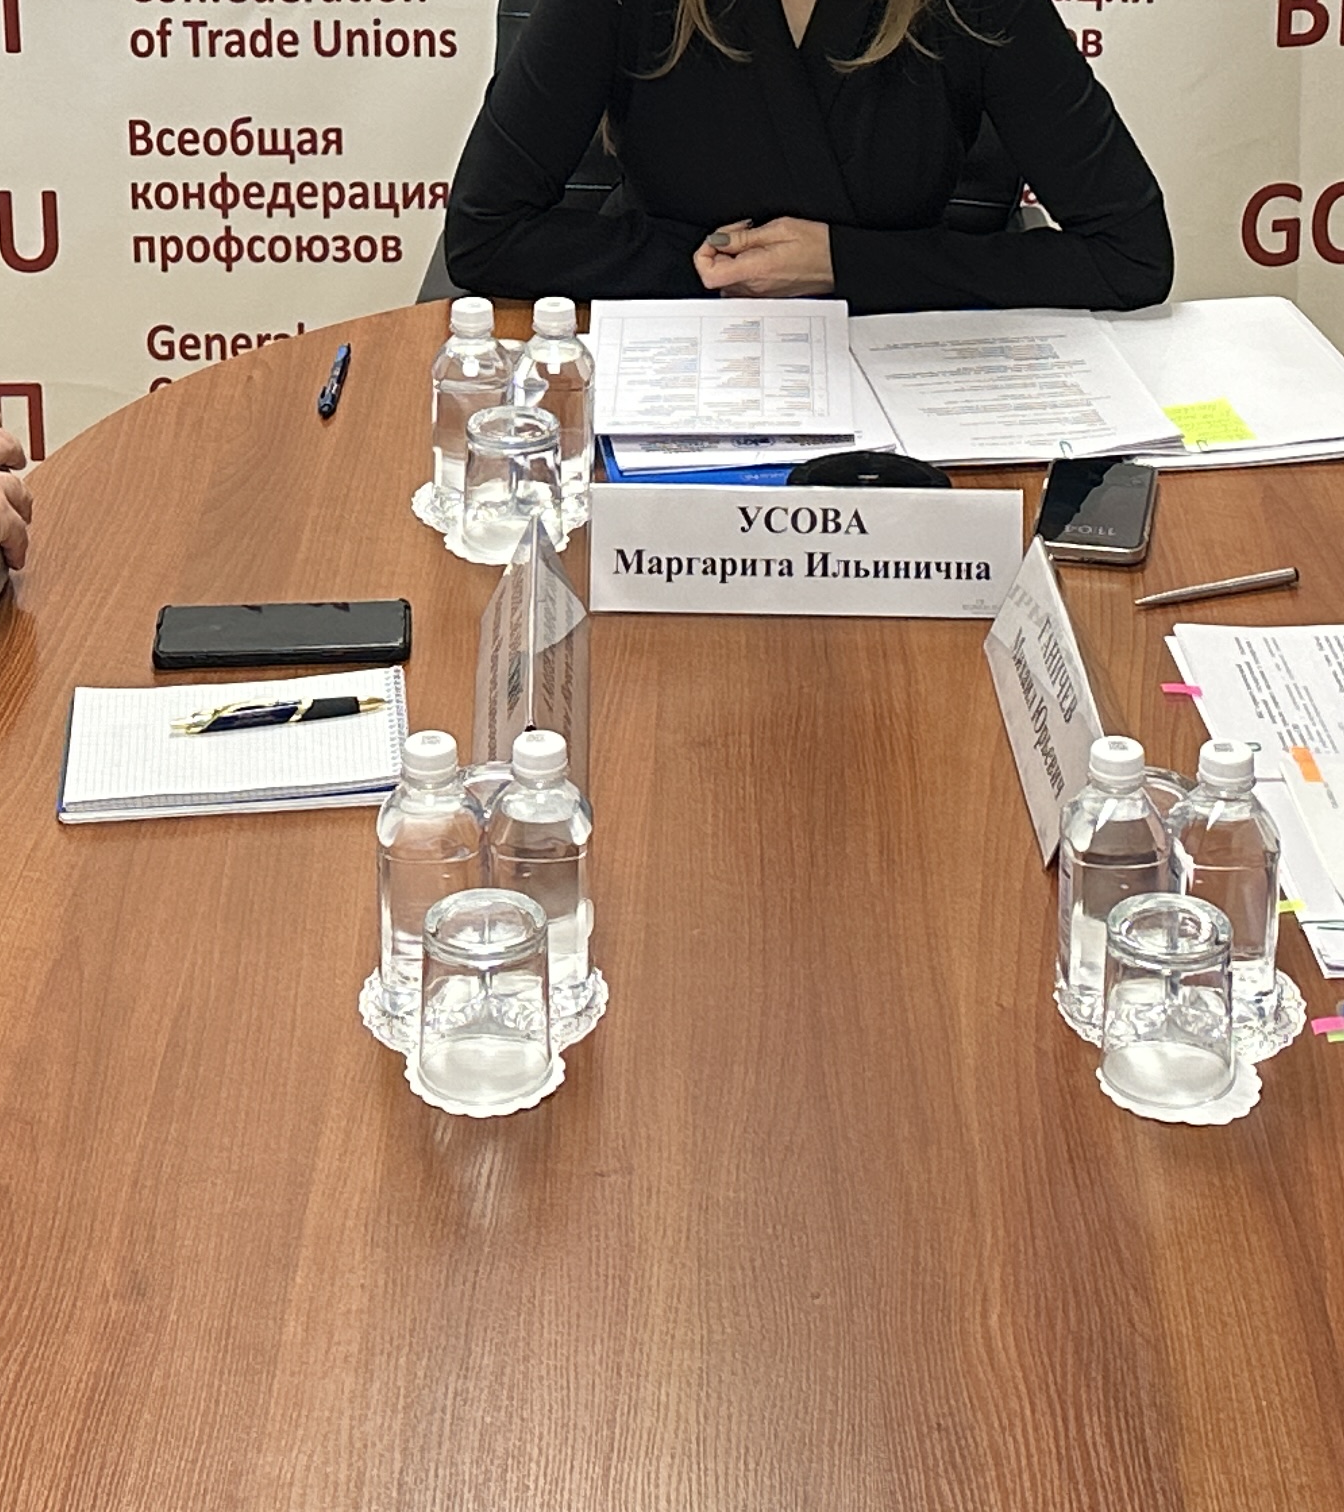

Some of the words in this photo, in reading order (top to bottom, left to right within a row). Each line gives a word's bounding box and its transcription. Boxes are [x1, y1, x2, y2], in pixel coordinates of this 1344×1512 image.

[129, 18, 171, 58] of
[183, 19, 299, 58] Trade
[312, 20, 458, 58] Unions
[127, 116, 344, 163] Всеобщая
[130, 172, 450, 218] конфедерация
[132, 226, 403, 273] профсоюзов
[736, 505, 870, 536] УСОВА
[612, 547, 795, 584] Маргарита
[804, 551, 993, 581] Ильинична
